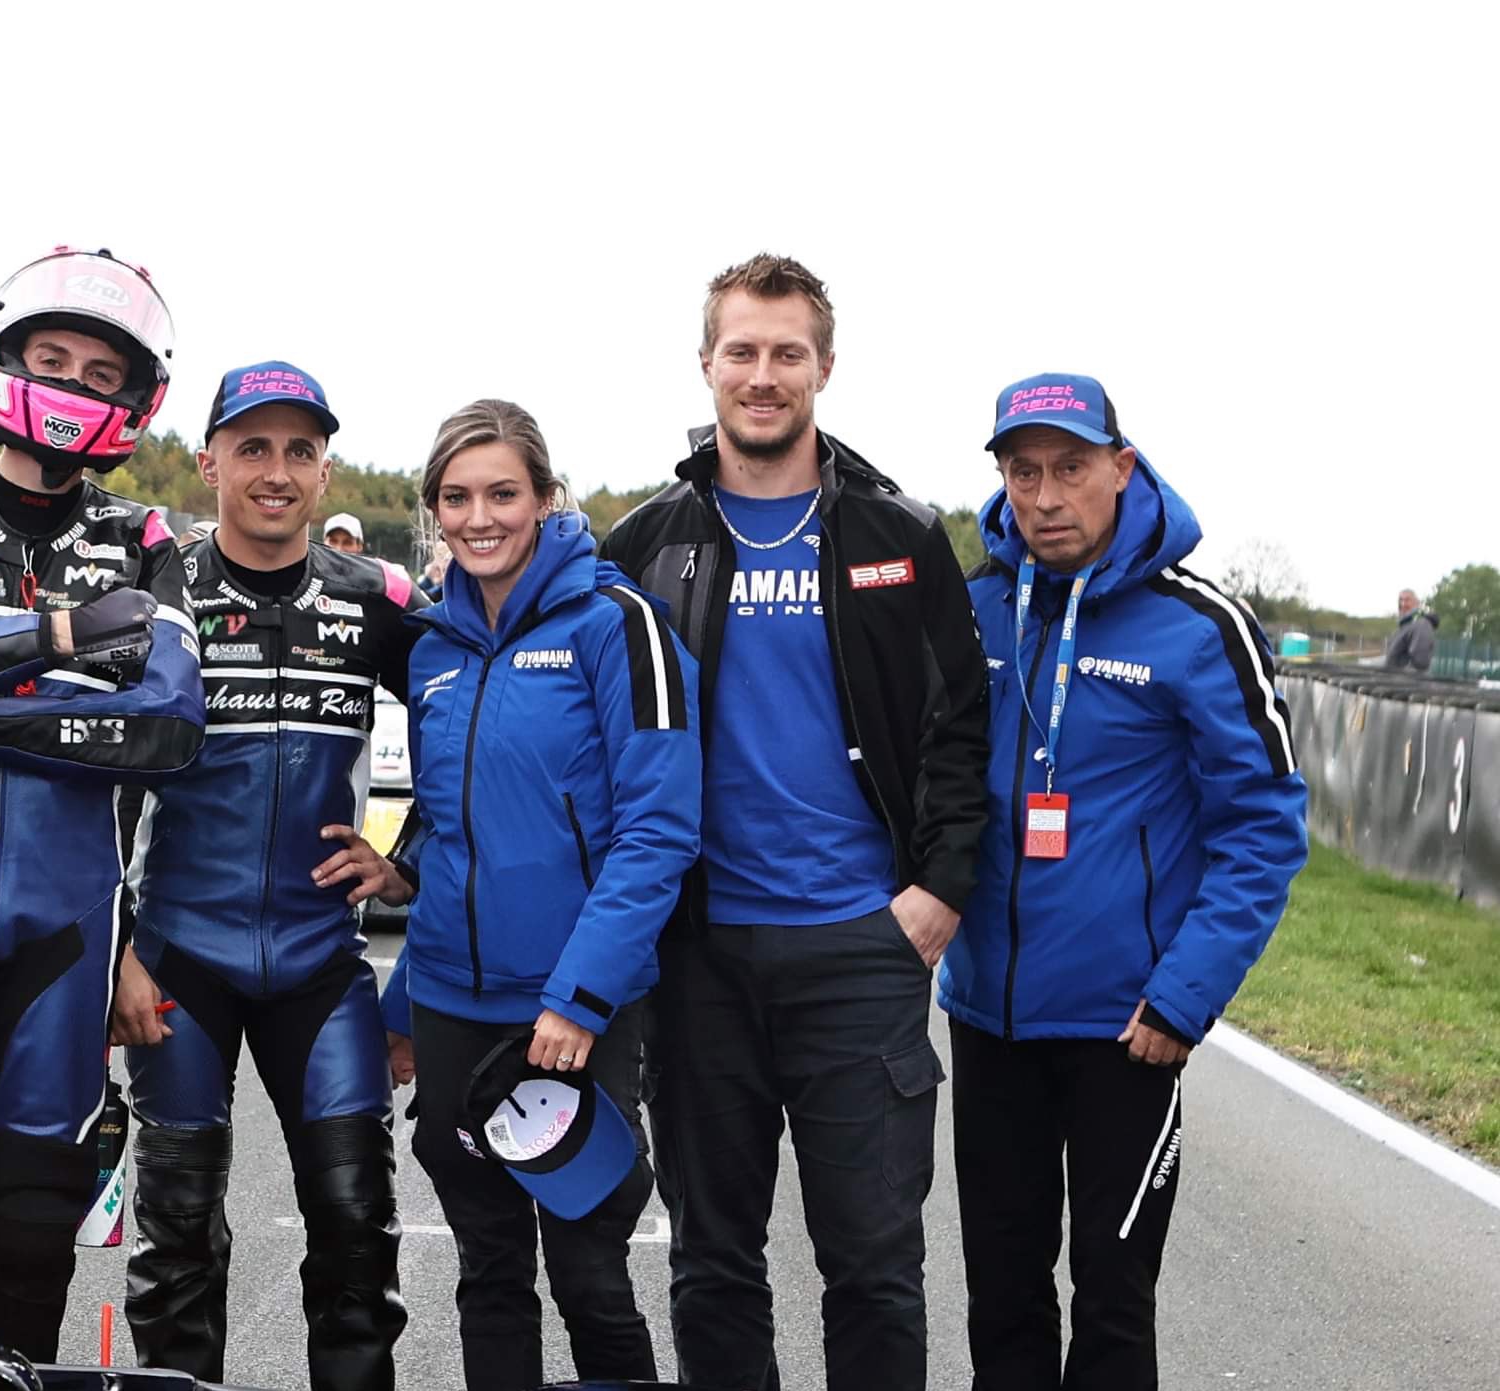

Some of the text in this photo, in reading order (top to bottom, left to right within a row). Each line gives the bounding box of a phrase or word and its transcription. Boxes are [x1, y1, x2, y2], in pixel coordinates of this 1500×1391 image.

[45, 419, 81, 437] MOTO
[50, 521, 88, 553] YAMAHA
[850, 562, 908, 583] BS
[217, 579, 258, 610] YAMAHA
[293, 577, 325, 611] YAMAHA
[317, 620, 364, 645] MVT
[527, 650, 574, 664] YAMAHA
[1095, 658, 1151, 682] YAMAHA
[1449, 736, 1465, 835] 3
